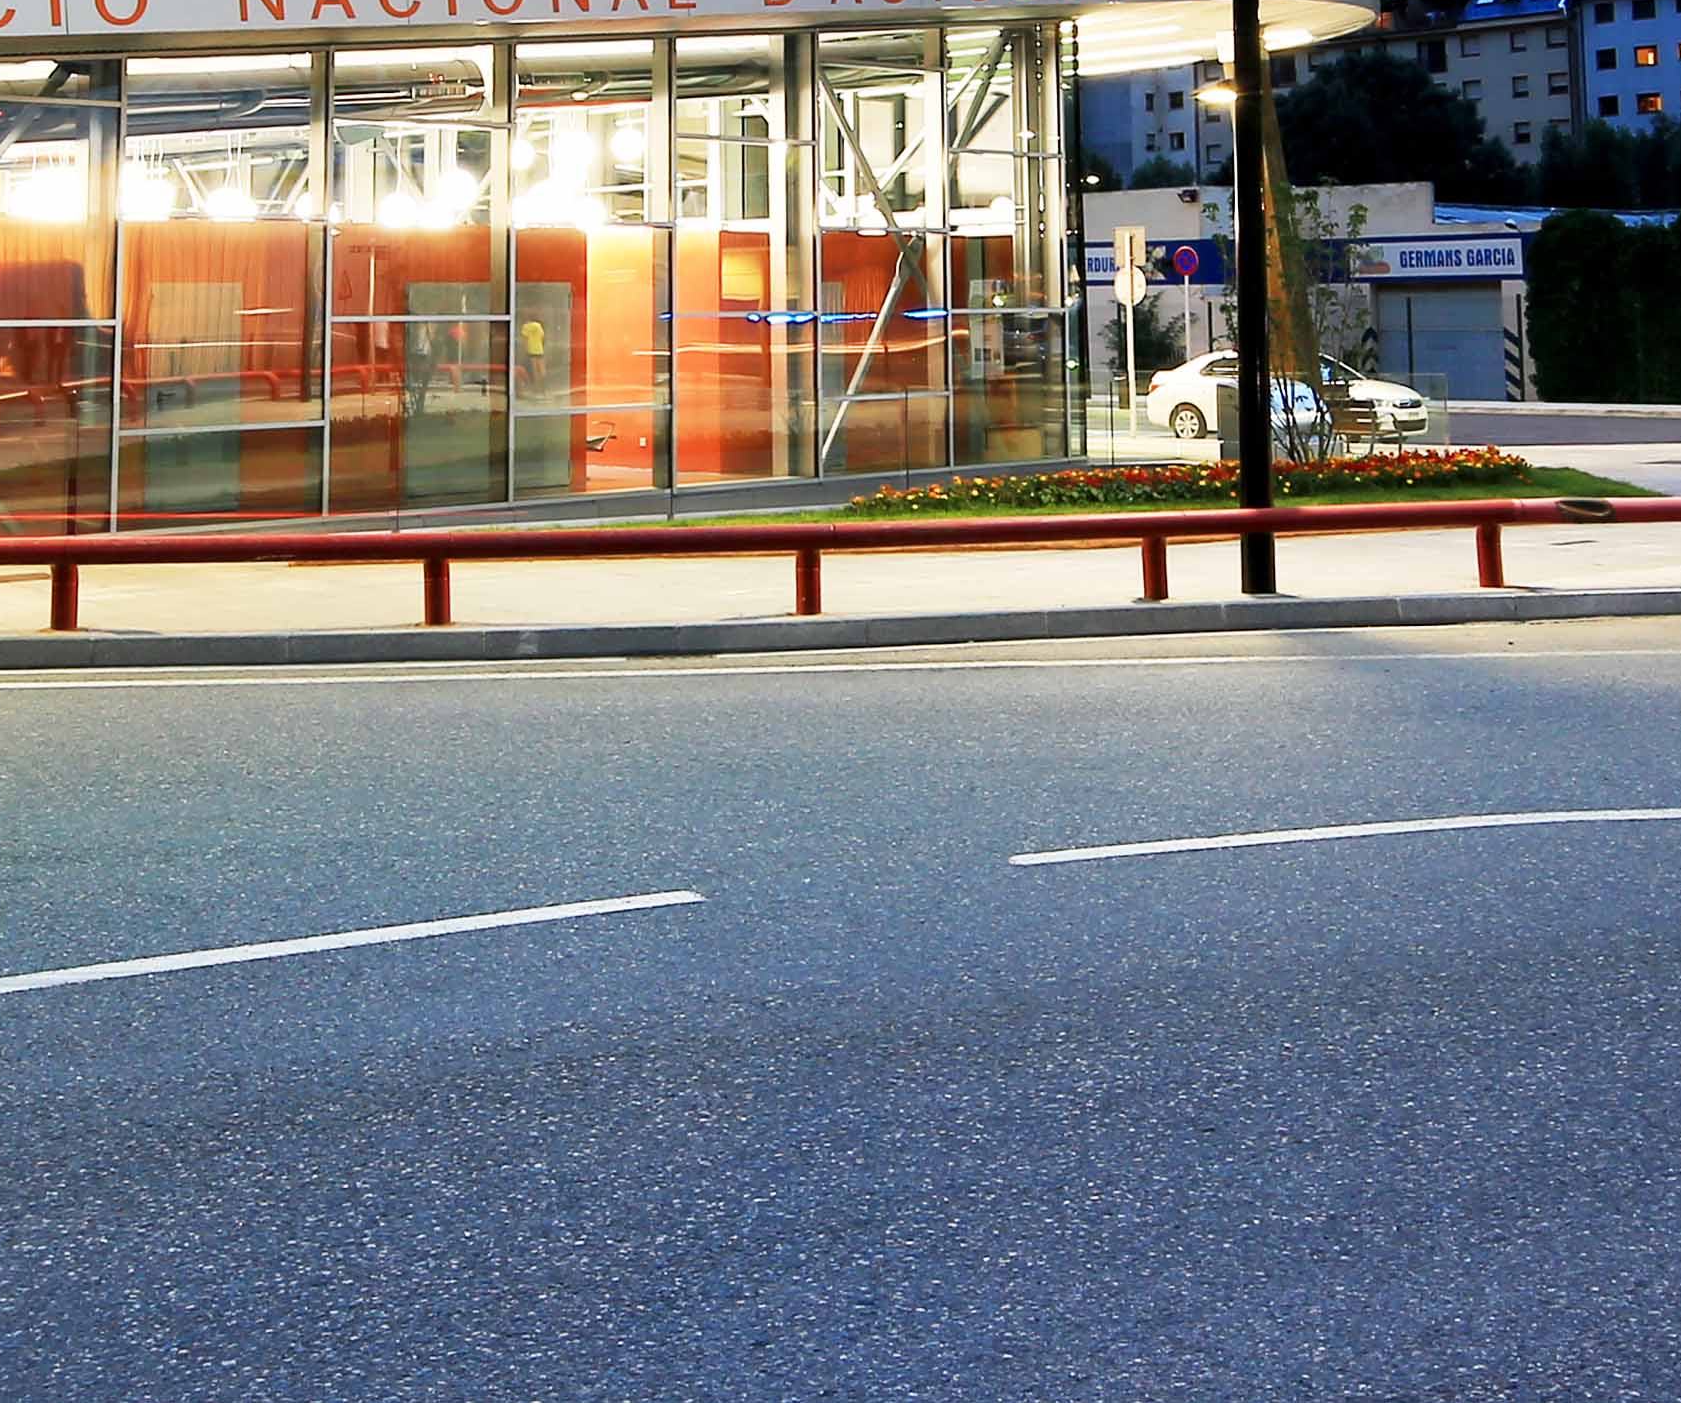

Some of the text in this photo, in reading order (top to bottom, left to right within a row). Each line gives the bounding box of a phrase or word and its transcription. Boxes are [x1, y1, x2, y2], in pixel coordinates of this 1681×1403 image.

[1087, 256, 1120, 273] RDUR
[1399, 247, 1516, 269] GERMANS GARCIA
